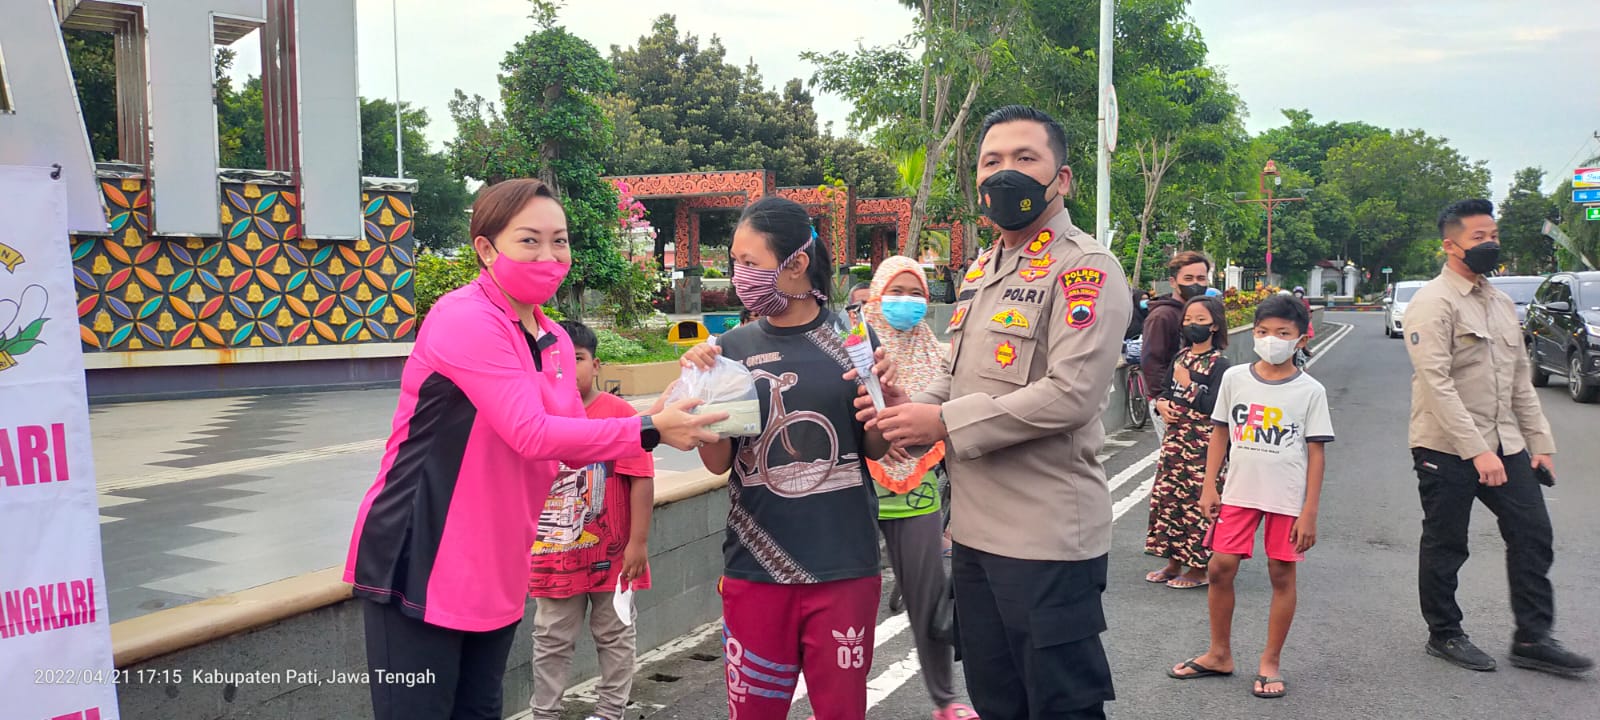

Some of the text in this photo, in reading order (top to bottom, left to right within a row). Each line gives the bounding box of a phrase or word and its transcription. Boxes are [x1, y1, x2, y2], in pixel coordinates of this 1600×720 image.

[1002, 288, 1045, 304] POLRI
[1232, 403, 1283, 432] GER
[1233, 424, 1289, 446] MANY
[837, 645, 864, 670] 03
